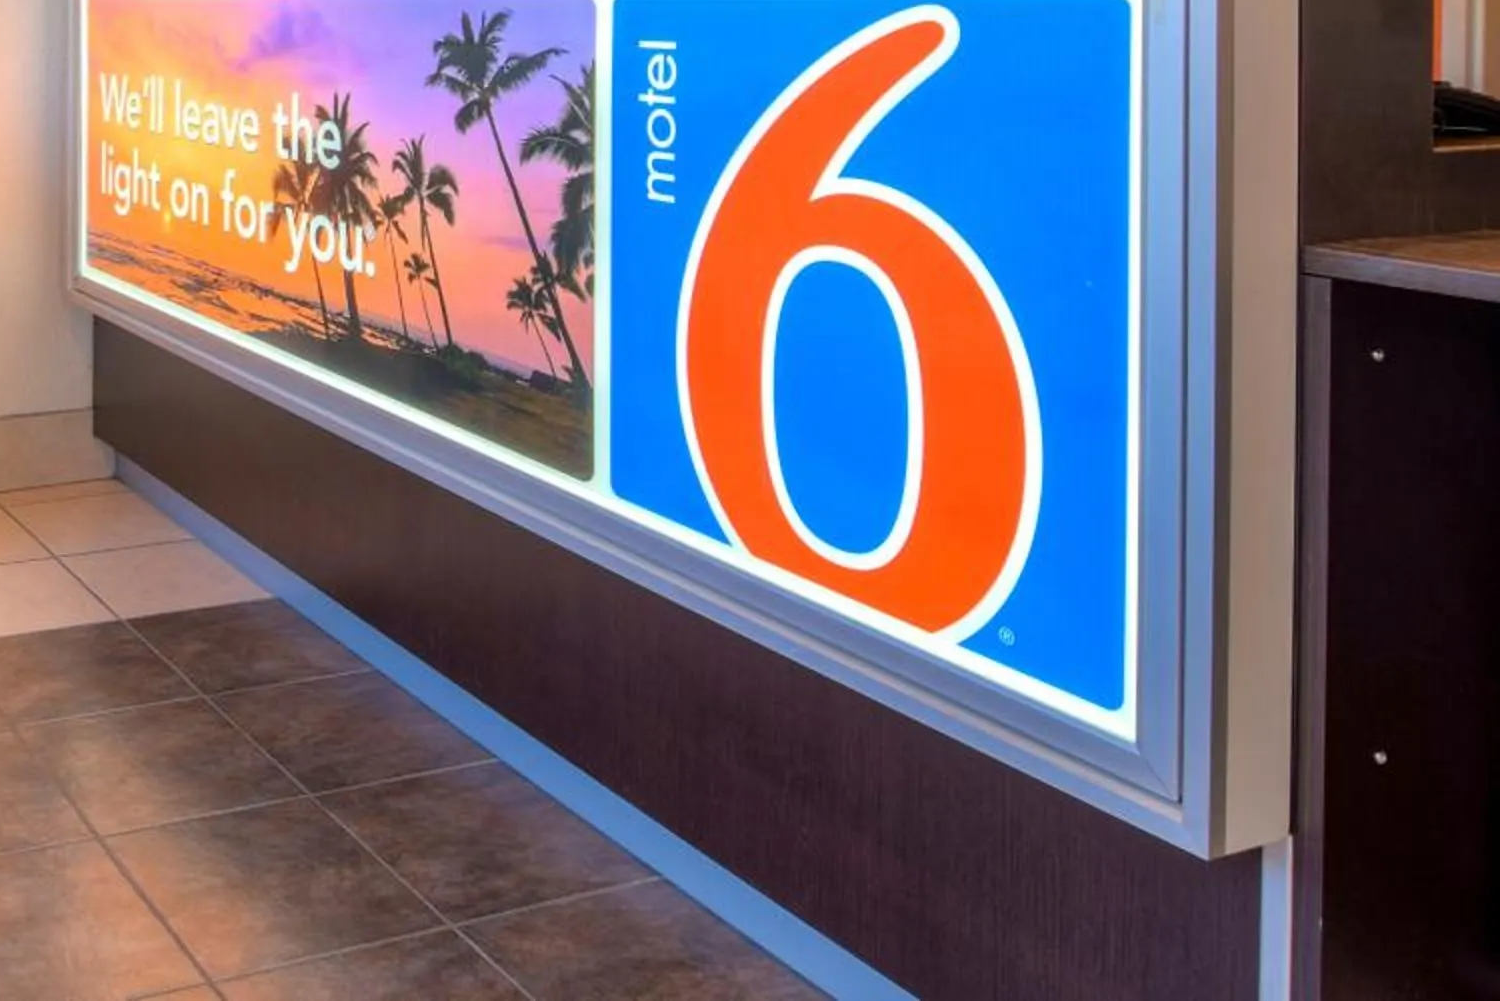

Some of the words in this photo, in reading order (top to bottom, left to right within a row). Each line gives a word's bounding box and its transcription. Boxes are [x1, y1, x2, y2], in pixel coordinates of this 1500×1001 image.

[100, 72, 164, 134] We'll
[174, 78, 260, 153] leave
[271, 91, 343, 171] the
[100, 140, 162, 217] light
[169, 177, 210, 226] on
[220, 167, 275, 244] for
[638, 39, 678, 204] motel
[677, 4, 1043, 647] 6
